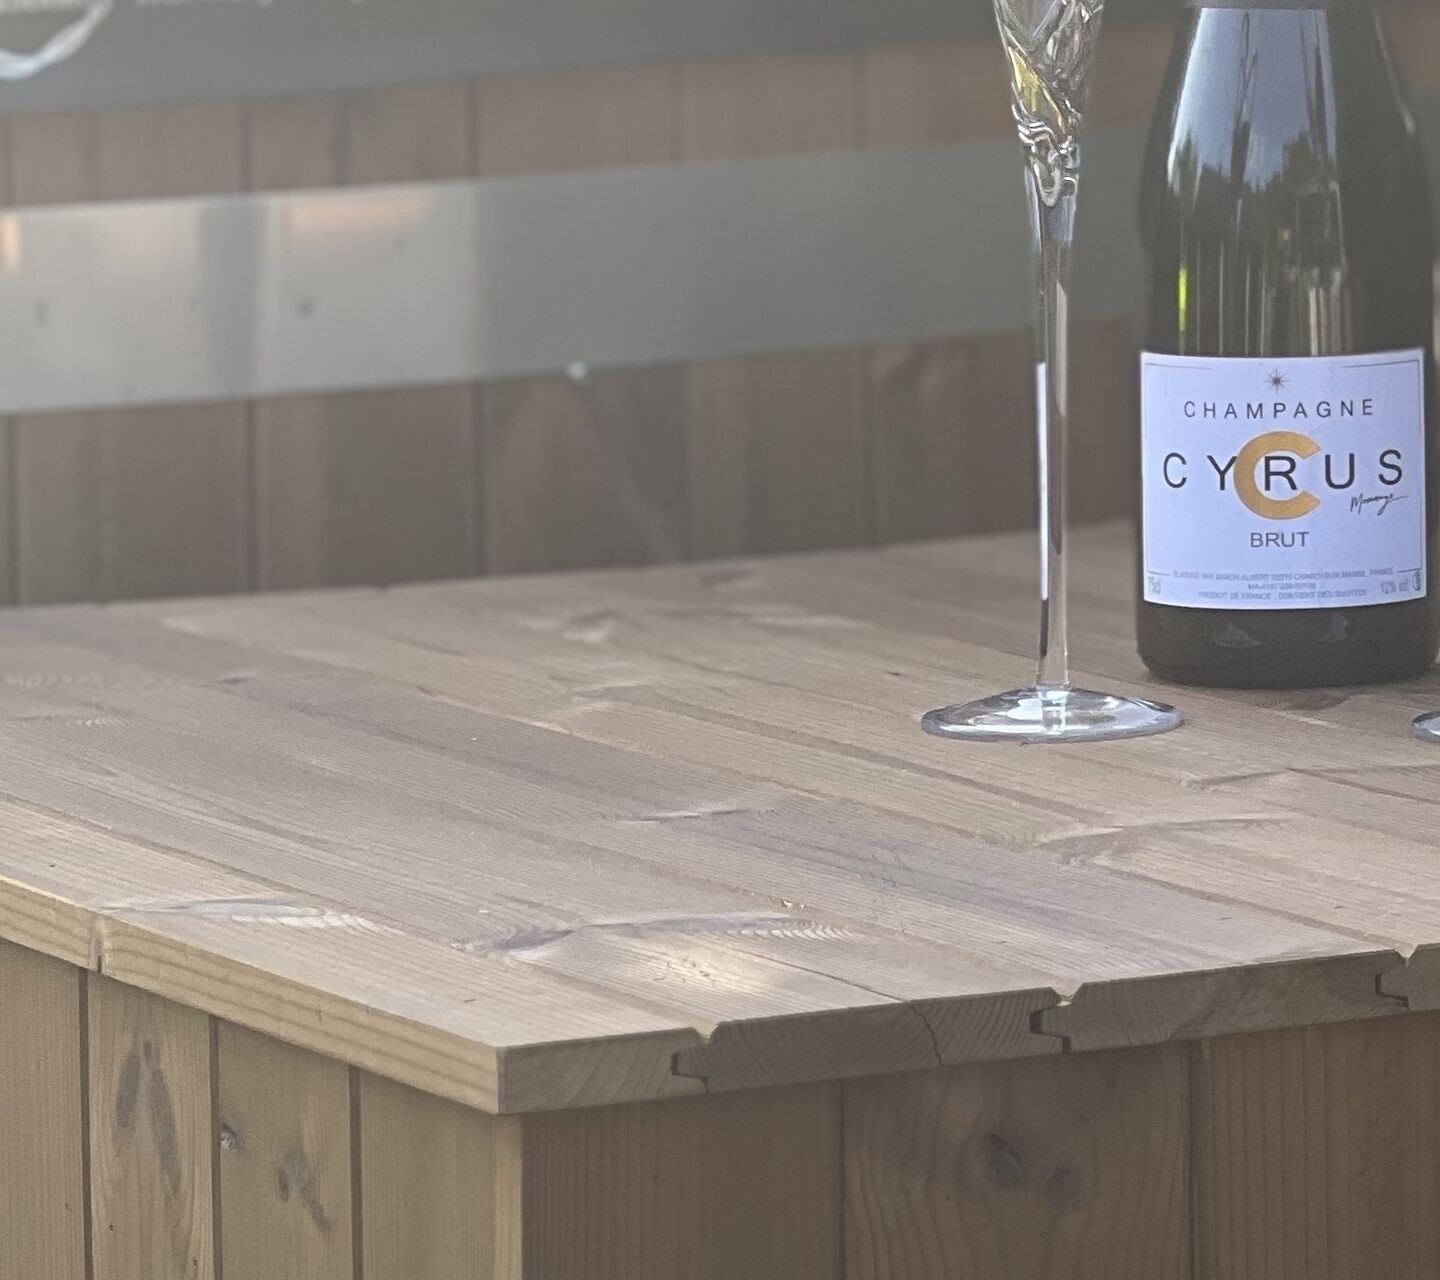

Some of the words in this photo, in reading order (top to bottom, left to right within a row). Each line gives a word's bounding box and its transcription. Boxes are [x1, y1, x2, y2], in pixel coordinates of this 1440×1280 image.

[1183, 398, 1374, 420] CHAMPAGNE
[1162, 448, 1404, 491] CYRUS
[1249, 531, 1310, 549] BRUT
